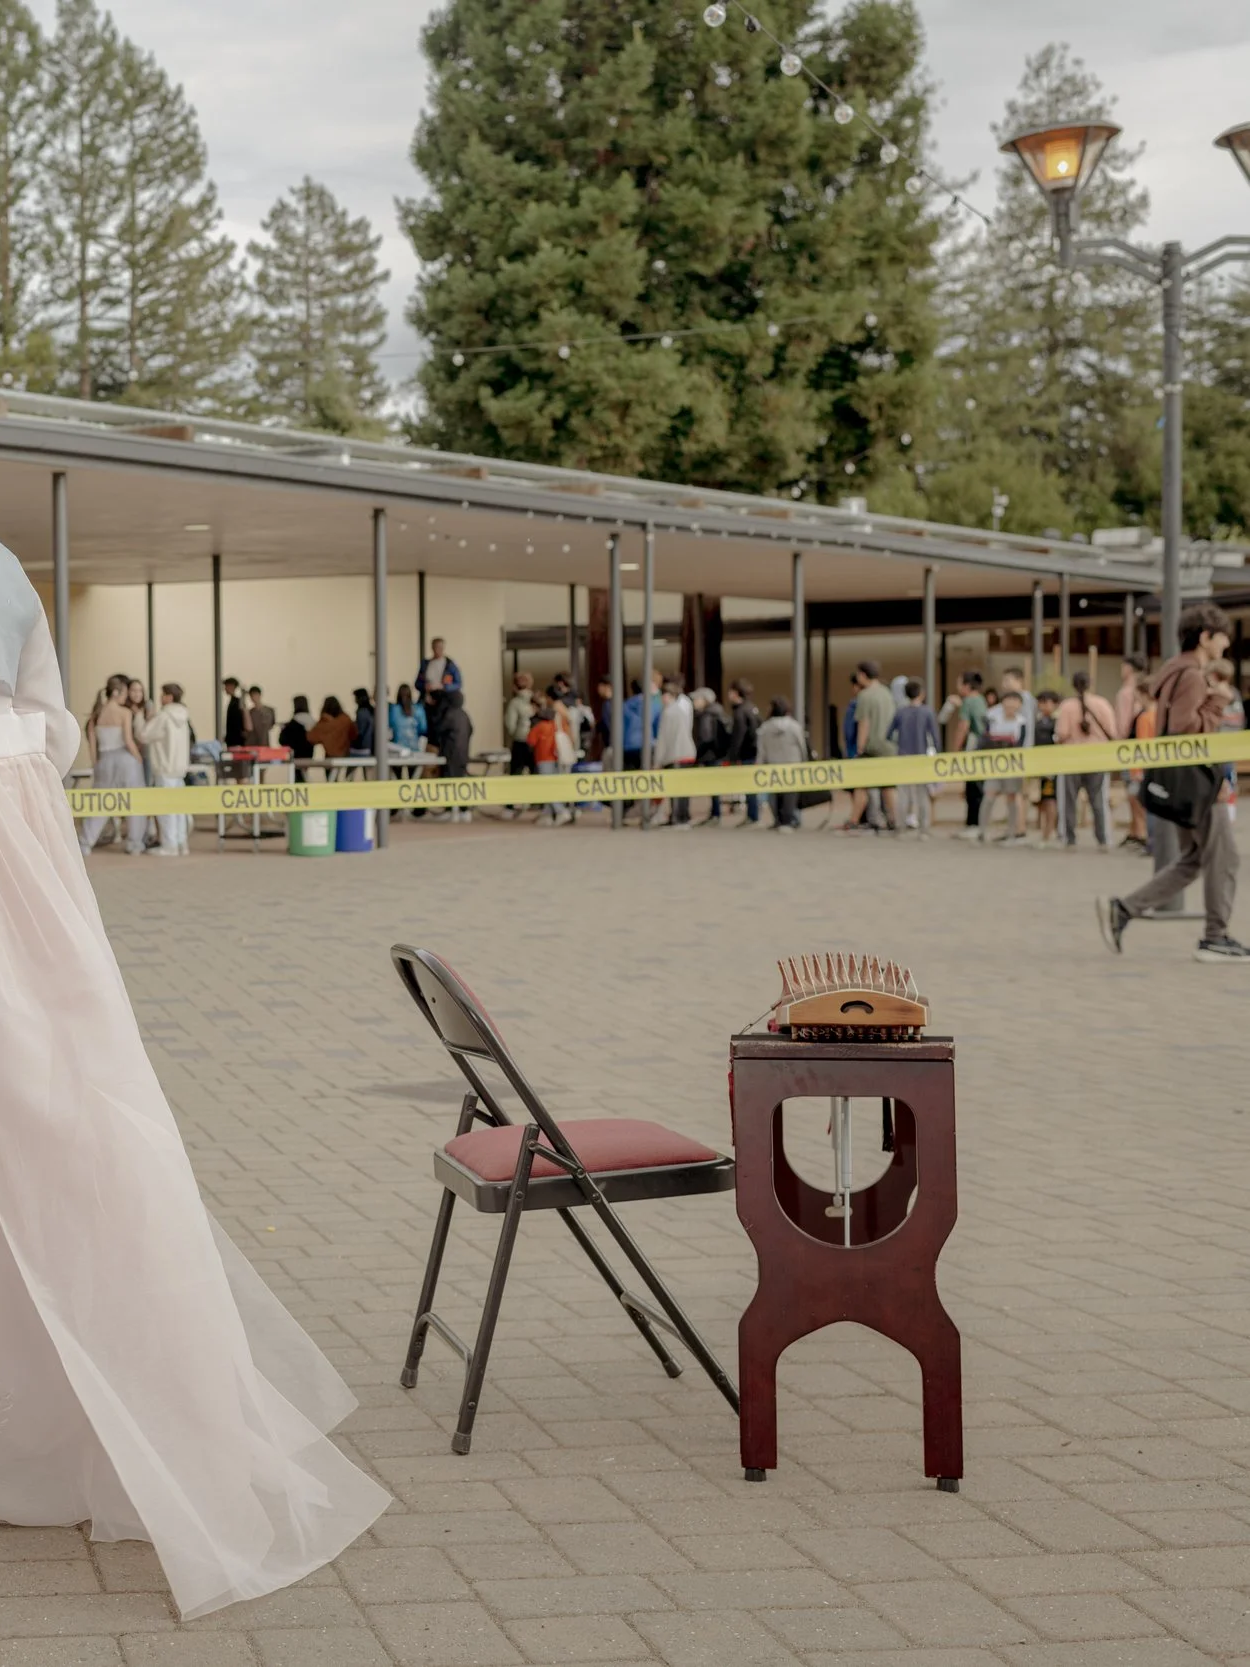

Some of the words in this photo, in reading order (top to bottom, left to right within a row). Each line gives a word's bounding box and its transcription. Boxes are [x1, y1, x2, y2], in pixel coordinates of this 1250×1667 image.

[71, 791, 131, 812] UTION
[221, 787, 309, 808] CAUTION
[399, 781, 487, 803] CAUTION
[575, 775, 665, 797] CAUTION
[754, 765, 843, 788] CAUTION
[934, 752, 1025, 777] CAUTION
[1117, 738, 1210, 764] CAUTION
